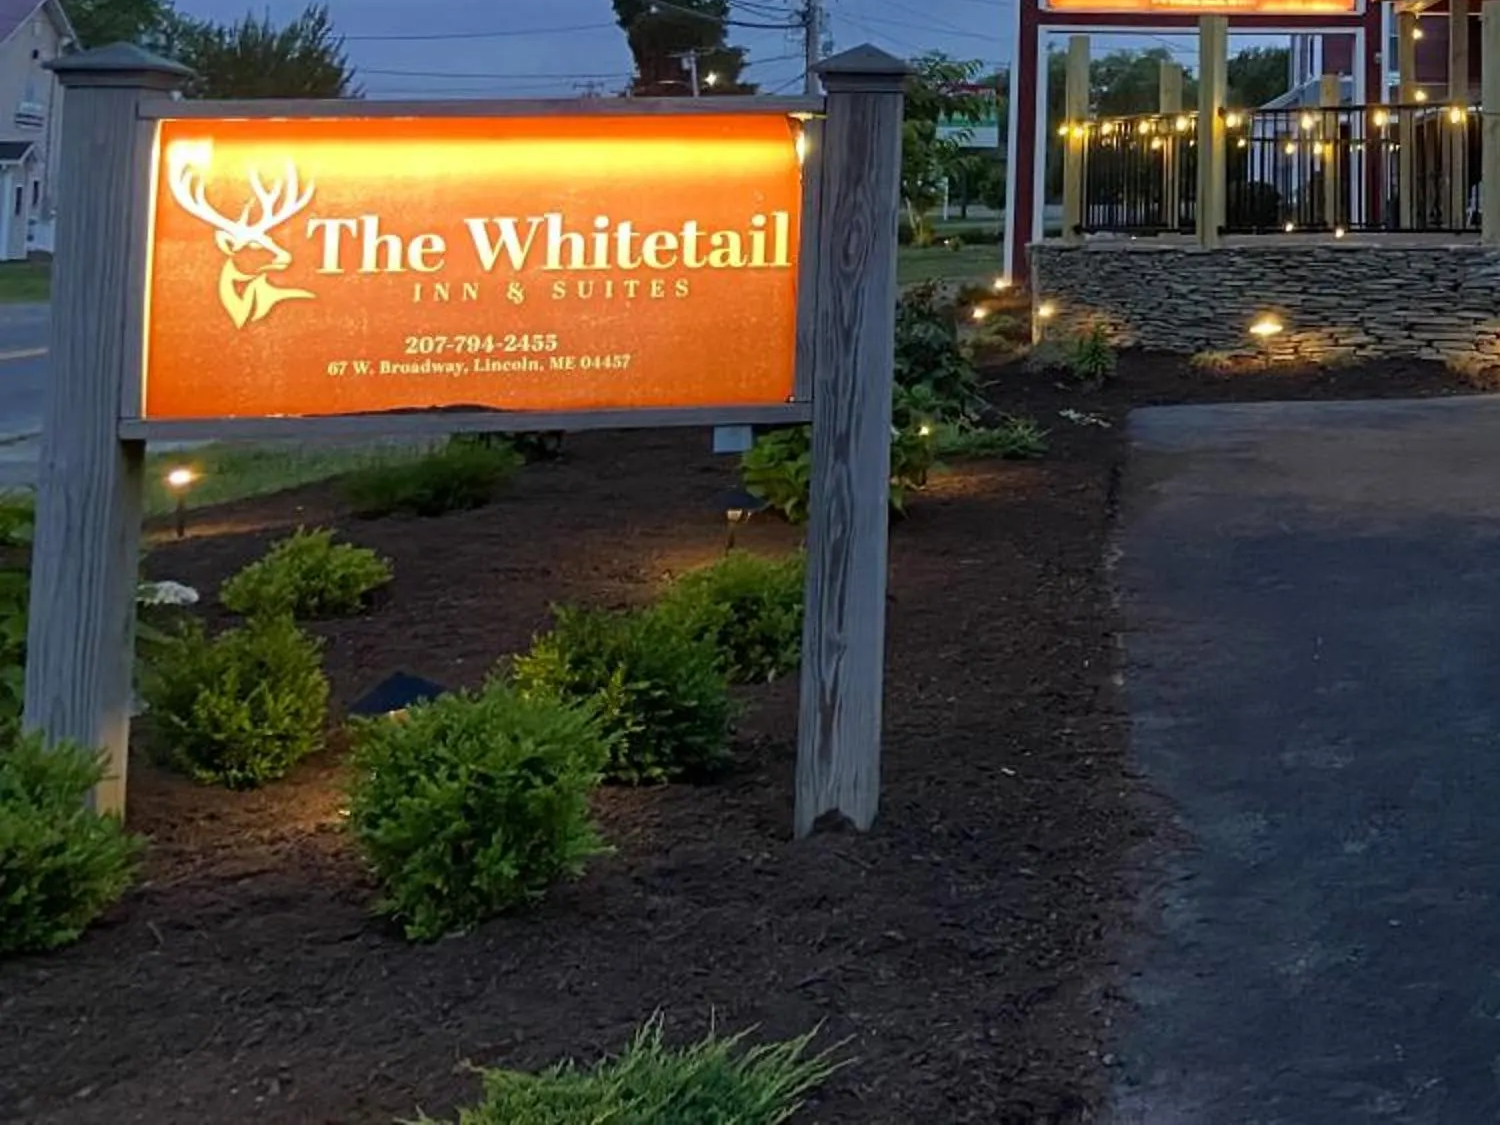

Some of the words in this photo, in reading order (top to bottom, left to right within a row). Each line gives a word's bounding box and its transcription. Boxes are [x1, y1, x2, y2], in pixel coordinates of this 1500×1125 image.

[306, 217, 446, 274] The
[466, 211, 792, 271] Whitetail
[413, 283, 479, 303] INN
[507, 281, 525, 304] &
[552, 279, 691, 299] SUITES
[404, 334, 558, 355] 207-794-2455
[327, 360, 348, 376] 67
[352, 360, 375, 375] W.
[379, 358, 469, 377] Broadway,
[549, 356, 577, 371] ME
[580, 353, 631, 370] 04457
